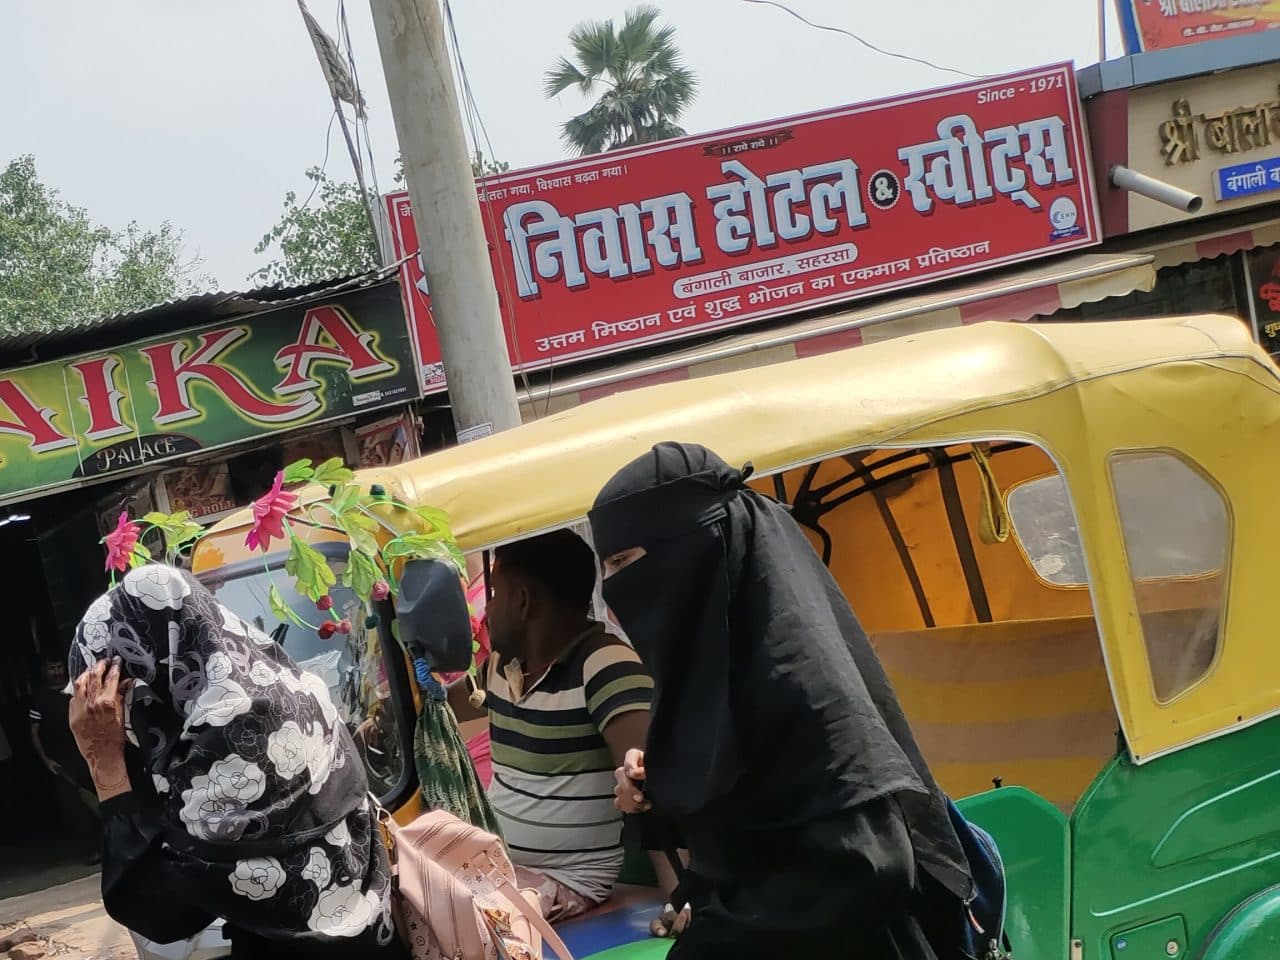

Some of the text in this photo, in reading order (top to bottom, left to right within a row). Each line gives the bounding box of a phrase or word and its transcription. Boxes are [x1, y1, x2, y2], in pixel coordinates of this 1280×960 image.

[977, 86, 1016, 104] Since
[1028, 74, 1064, 94] 1971
[536, 177, 572, 193] विश्वास
[1225, 165, 1267, 192] बंगाली
[503, 114, 1074, 298] निवास होटल & स्वीट्स
[680, 270, 732, 294] बंगाली
[796, 248, 851, 270] सहरसा
[535, 240, 991, 352] उत्तम मिष्ठान एवं शुद्ध भोजन का एकमात्र प्रतिष्ठान
[96, 436, 177, 471] PALACE
